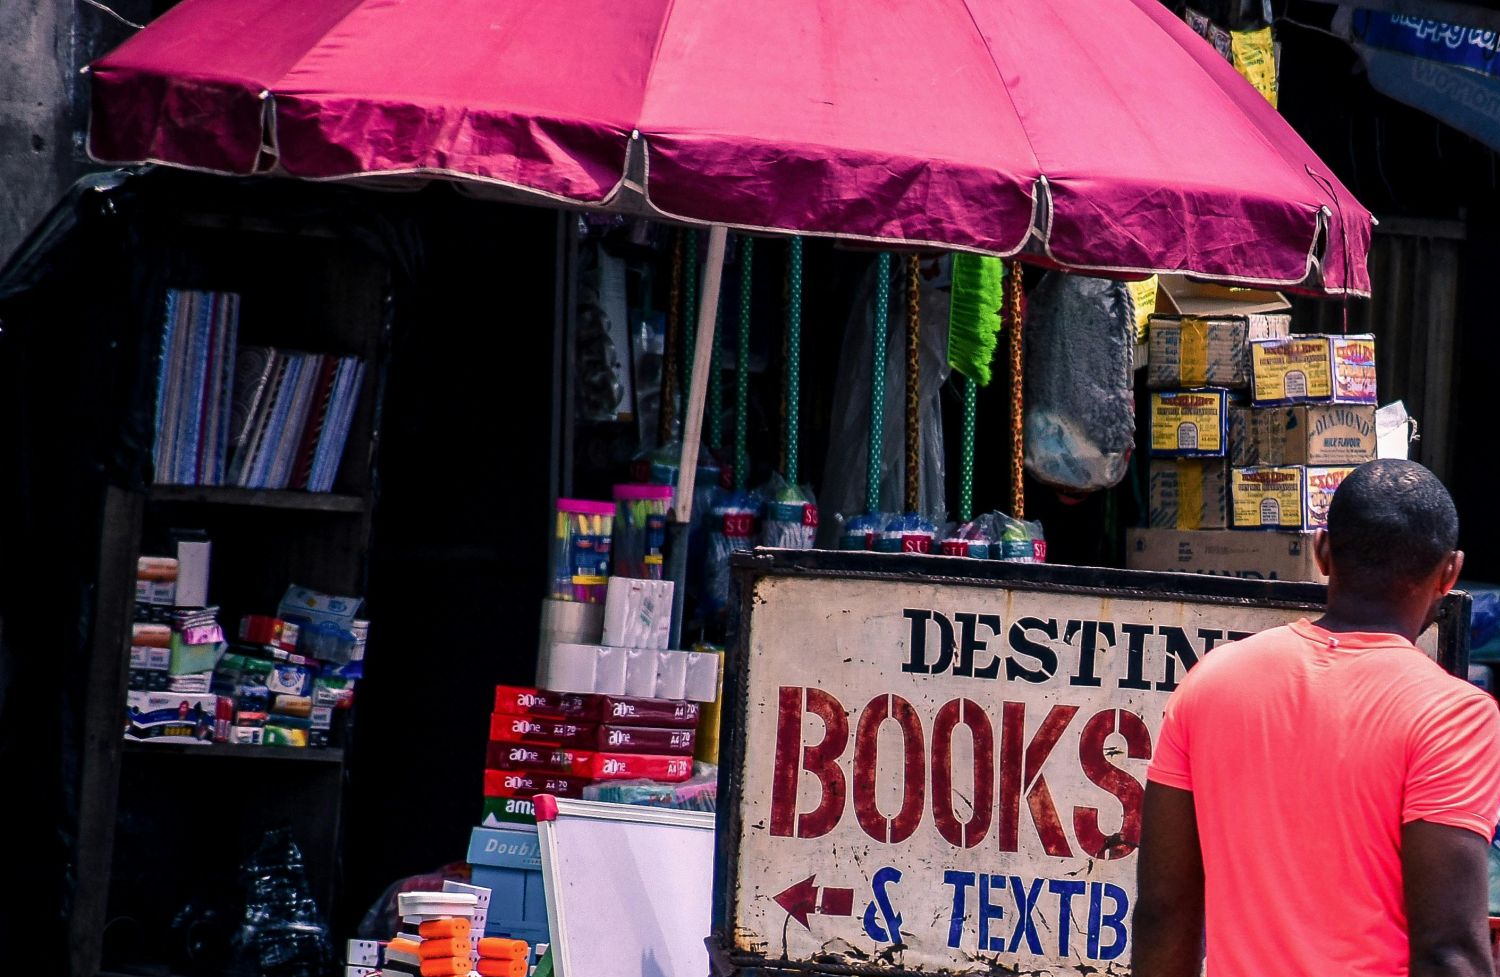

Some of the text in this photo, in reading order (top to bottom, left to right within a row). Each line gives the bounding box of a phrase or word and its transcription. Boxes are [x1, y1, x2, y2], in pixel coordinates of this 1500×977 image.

[1314, 410, 1370, 438] DIAMOND
[901, 608, 1256, 692] DESTIN
[674, 706, 684, 717] A4
[553, 726, 564, 735] A4
[566, 725, 577, 734] 70
[670, 735, 680, 746] A4
[681, 732, 691, 743] 70
[668, 764, 677, 775] A4
[769, 685, 1167, 860] BOOKS
[545, 781, 556, 790] A4
[558, 780, 568, 790] 70
[485, 838, 542, 856] Doubl
[863, 865, 1131, 961] & TEXTB
